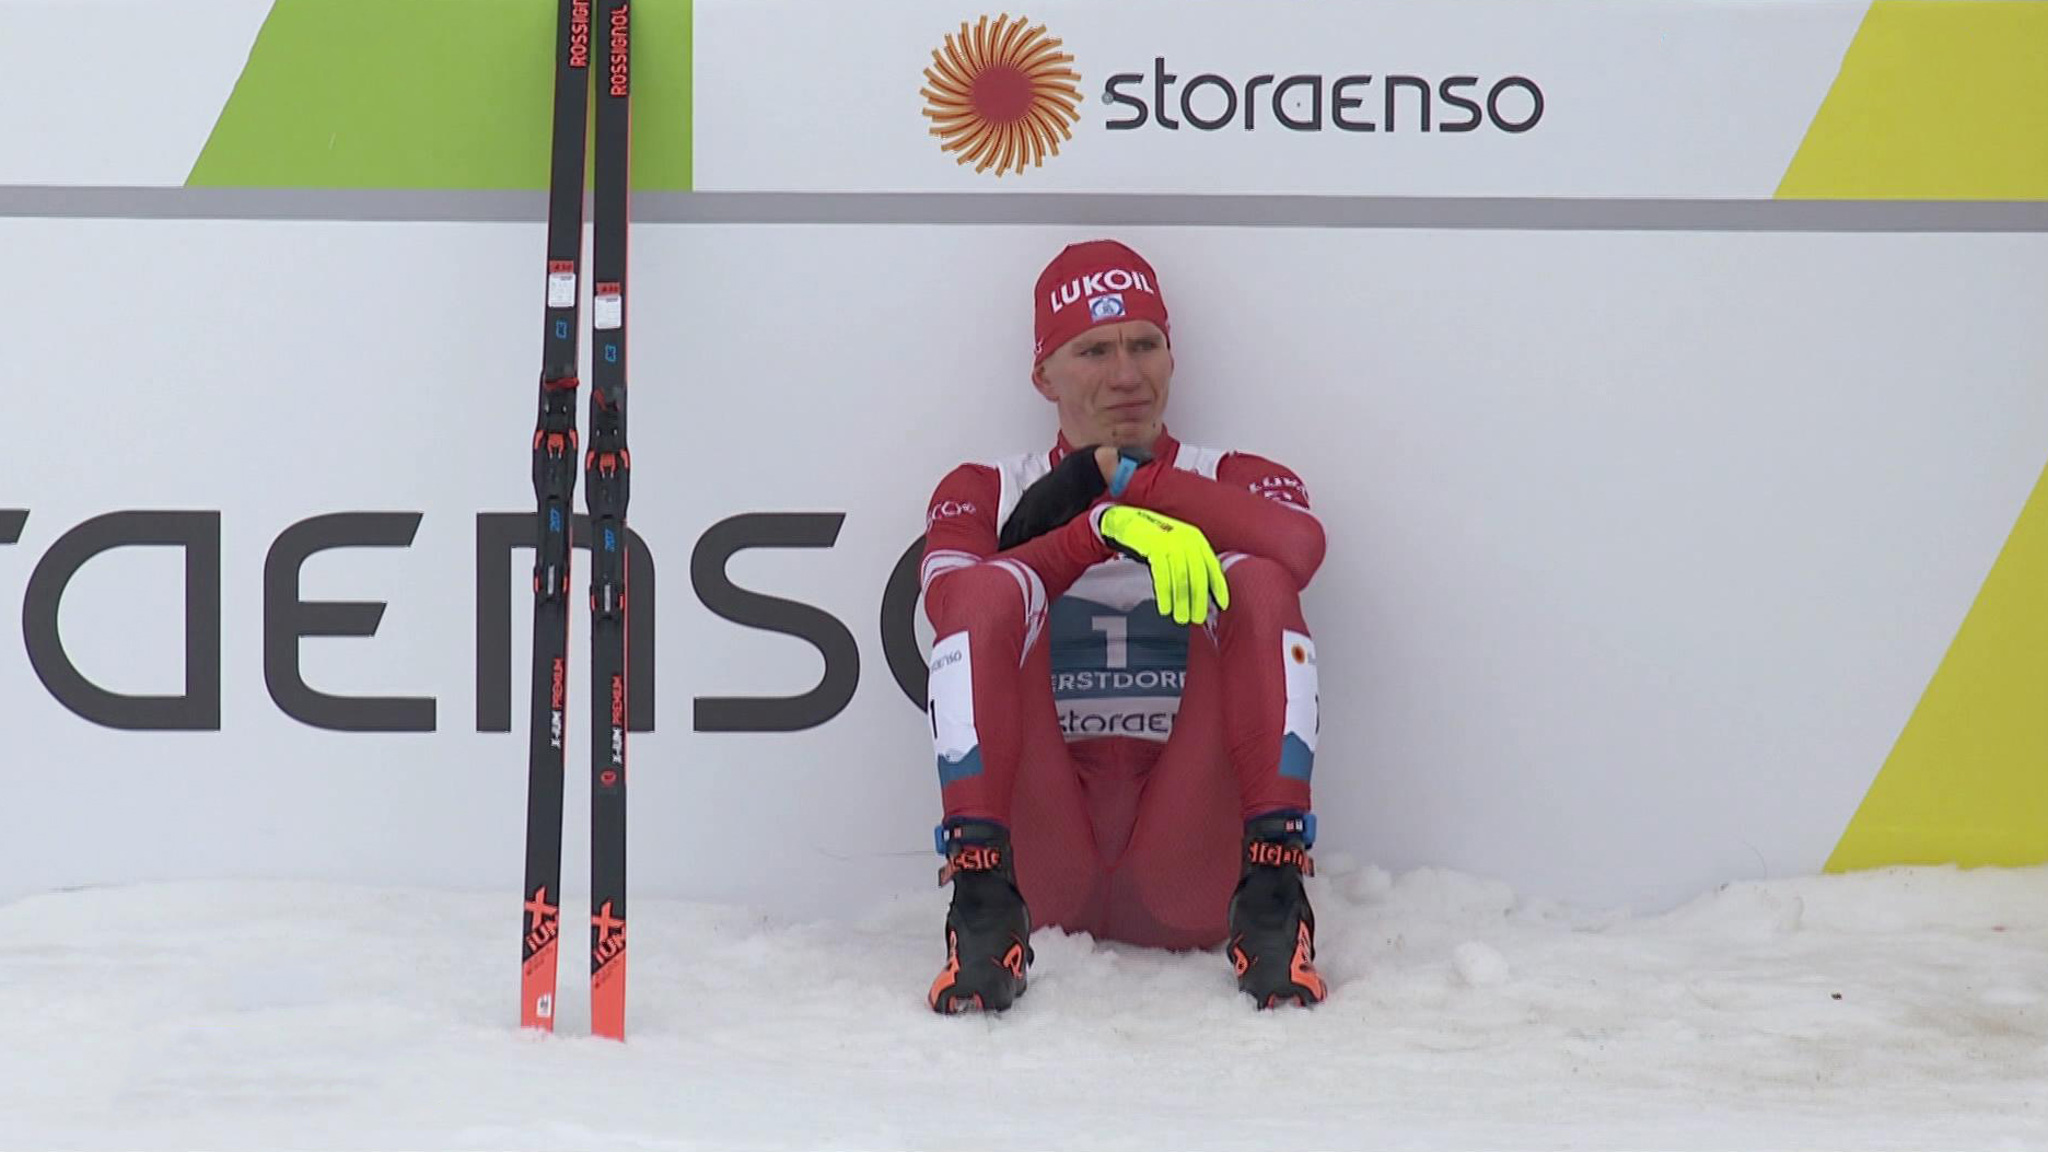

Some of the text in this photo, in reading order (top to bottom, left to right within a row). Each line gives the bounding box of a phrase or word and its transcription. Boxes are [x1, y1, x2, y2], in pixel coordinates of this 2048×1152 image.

[610, 4, 628, 96] ROSSIGNOL
[1104, 56, 1544, 133] storaenso
[1050, 268, 1154, 314] LUKOIL
[0, 509, 937, 733] aens
[1091, 615, 1128, 669] 1
[551, 657, 563, 710] PREMIUM
[611, 674, 622, 726] PREMIUM
